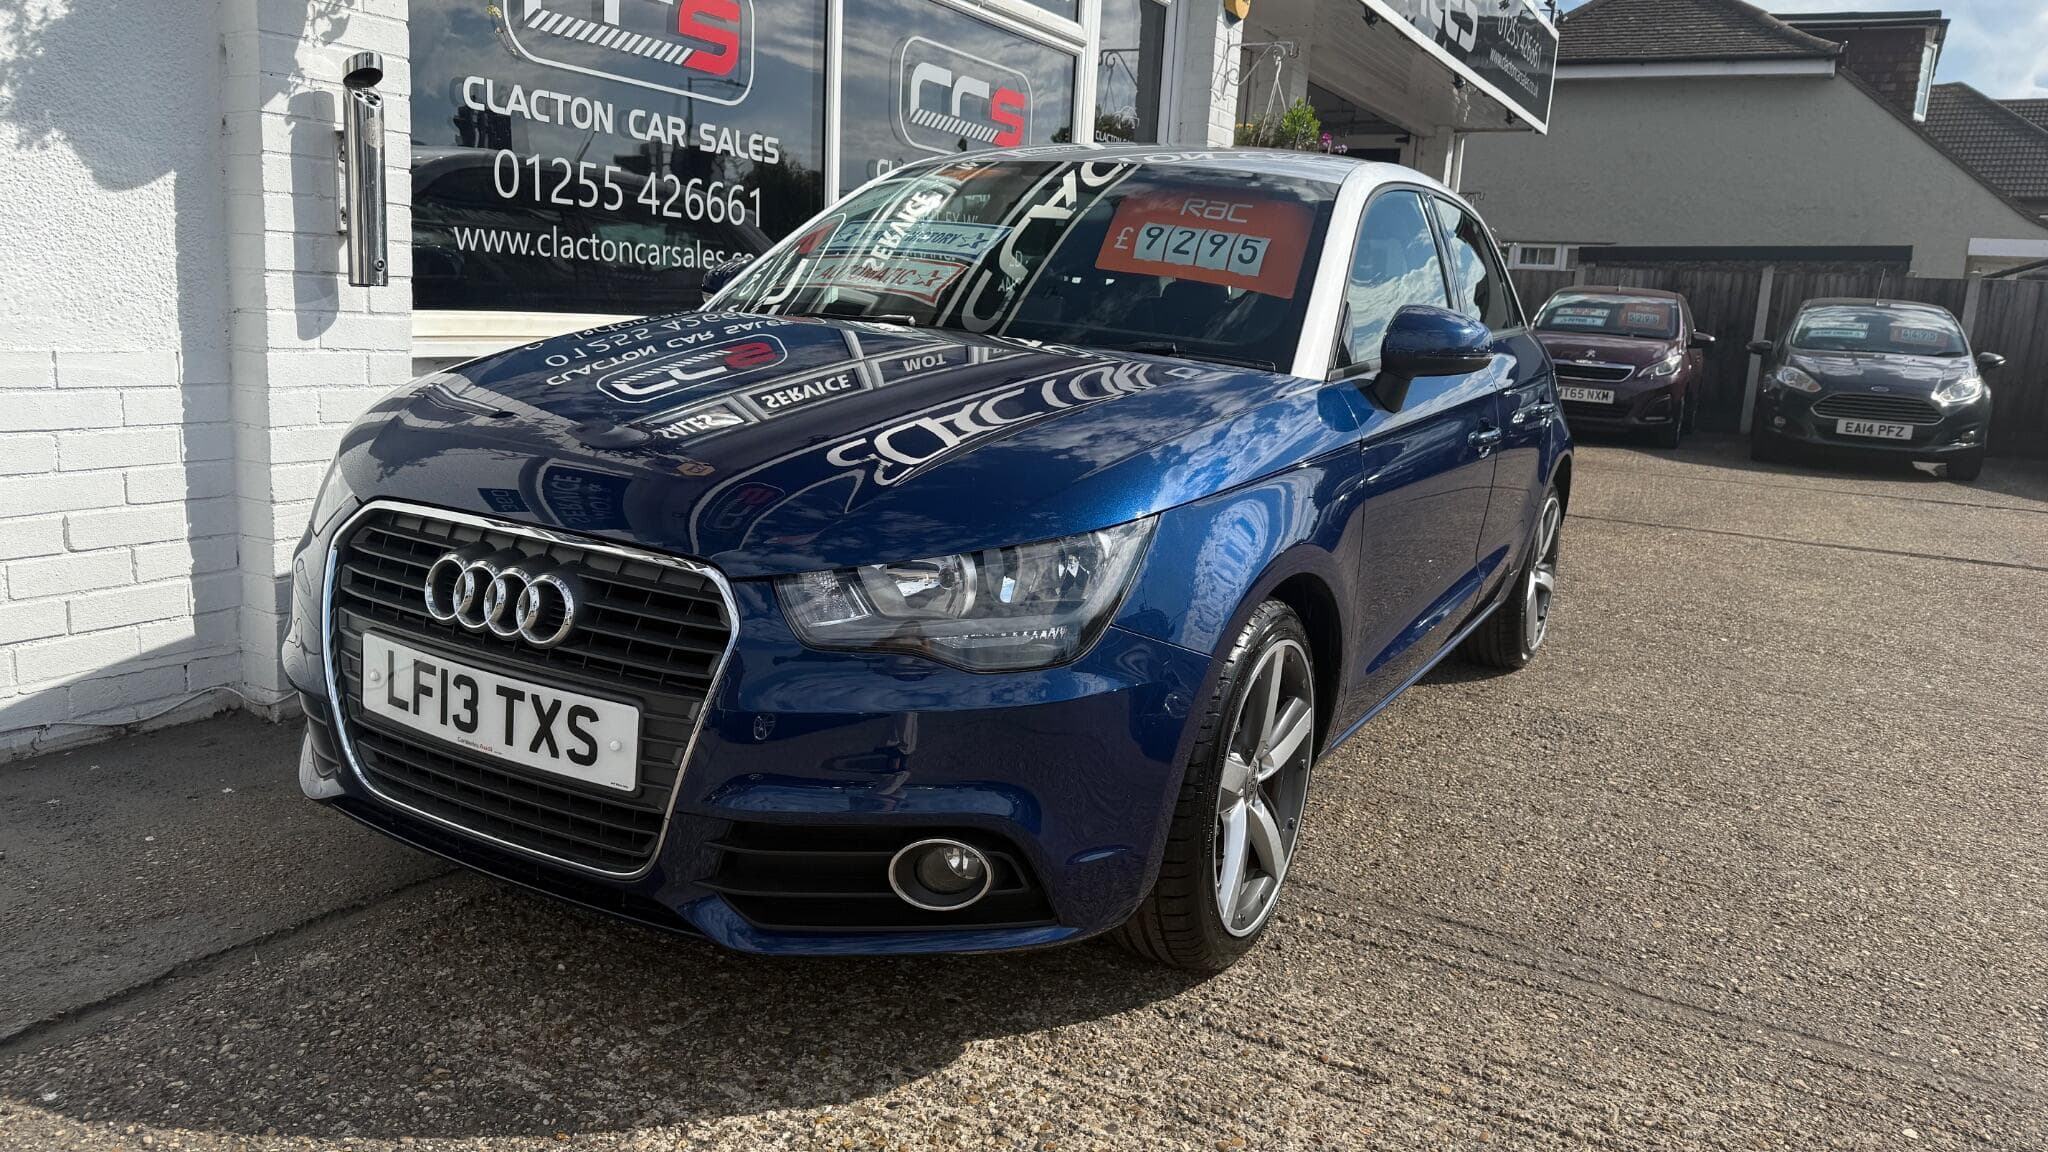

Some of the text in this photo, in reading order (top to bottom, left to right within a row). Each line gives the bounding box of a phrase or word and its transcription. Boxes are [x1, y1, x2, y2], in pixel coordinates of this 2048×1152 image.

[1497, 12, 1520, 50] 01255
[463, 75, 780, 165] CLACTON CAR SALES
[910, 62, 1025, 147] CCS
[494, 149, 761, 228] 01255 426661
[453, 225, 755, 270] www.clactoncarsales
[1146, 226, 1262, 265] 9295
[1586, 389, 1610, 401] NXM
[1844, 421, 1905, 438] EA14 PFZ
[387, 649, 600, 767] LF13 TXS
